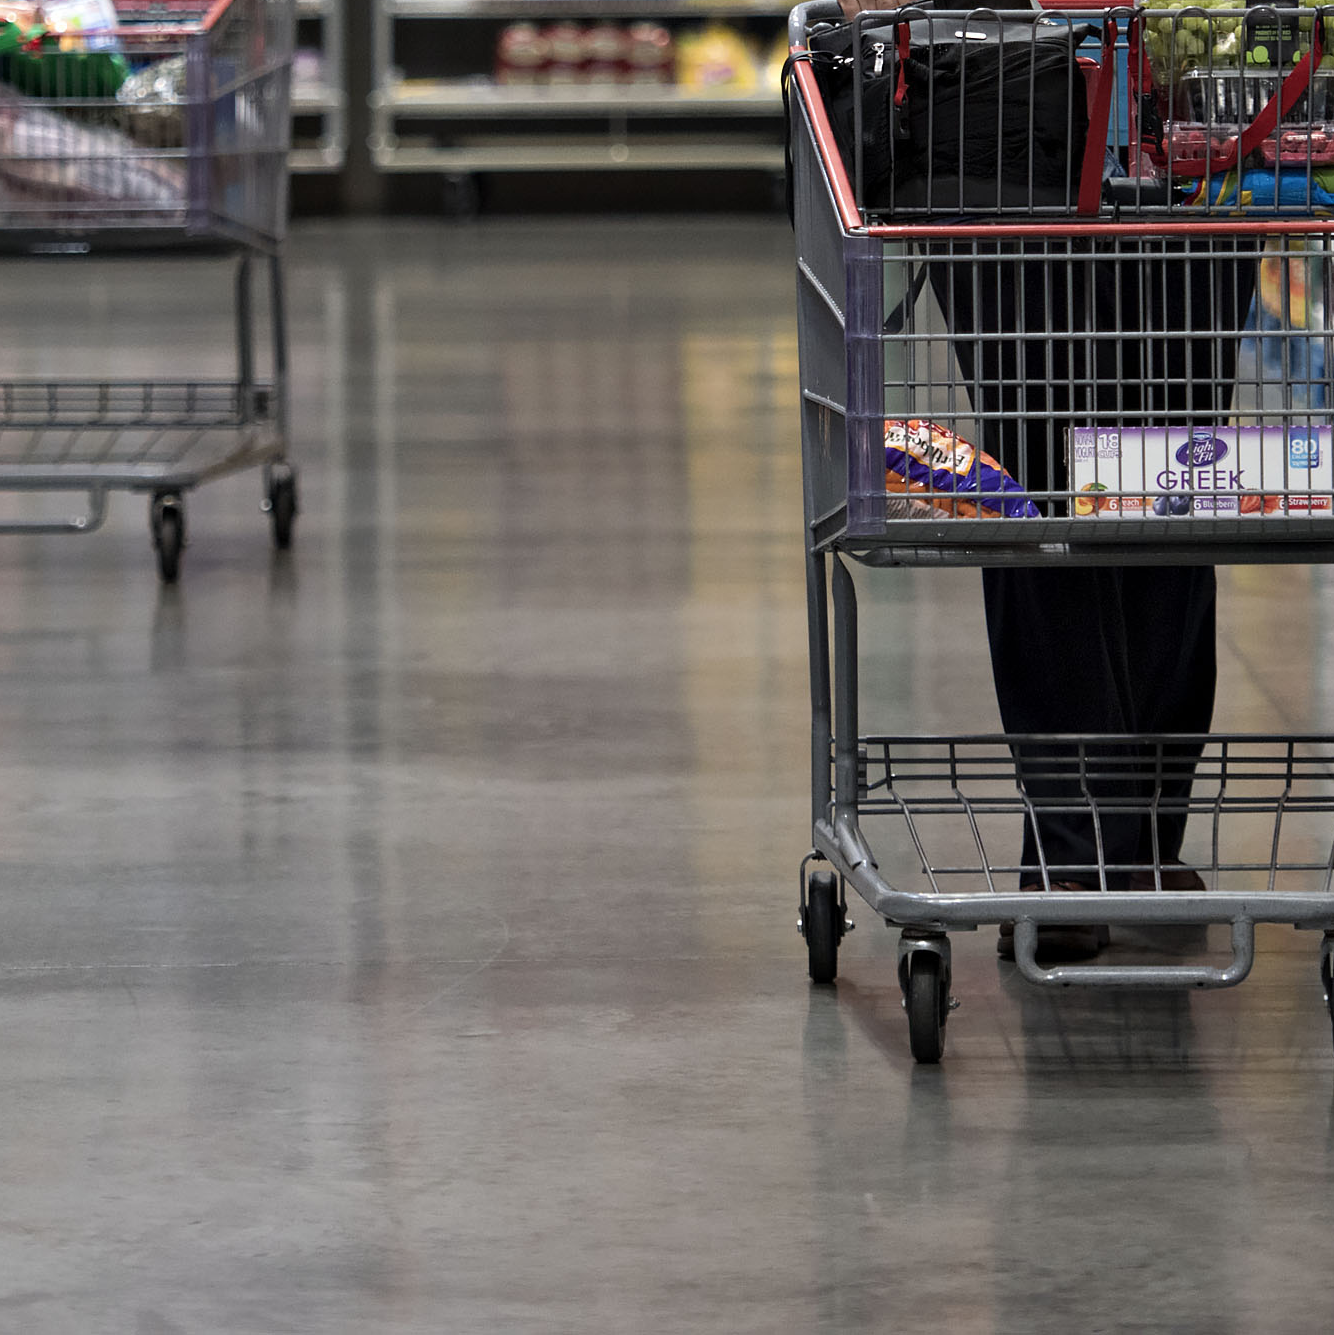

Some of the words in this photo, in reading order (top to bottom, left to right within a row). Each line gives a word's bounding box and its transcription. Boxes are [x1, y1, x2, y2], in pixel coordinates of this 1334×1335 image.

[1098, 433, 1121, 450] 18
[1291, 439, 1318, 455] 80
[1156, 470, 1246, 491] GREEK
[1109, 499, 1117, 510] 6
[1121, 497, 1140, 507] each
[1193, 499, 1202, 510] 6
